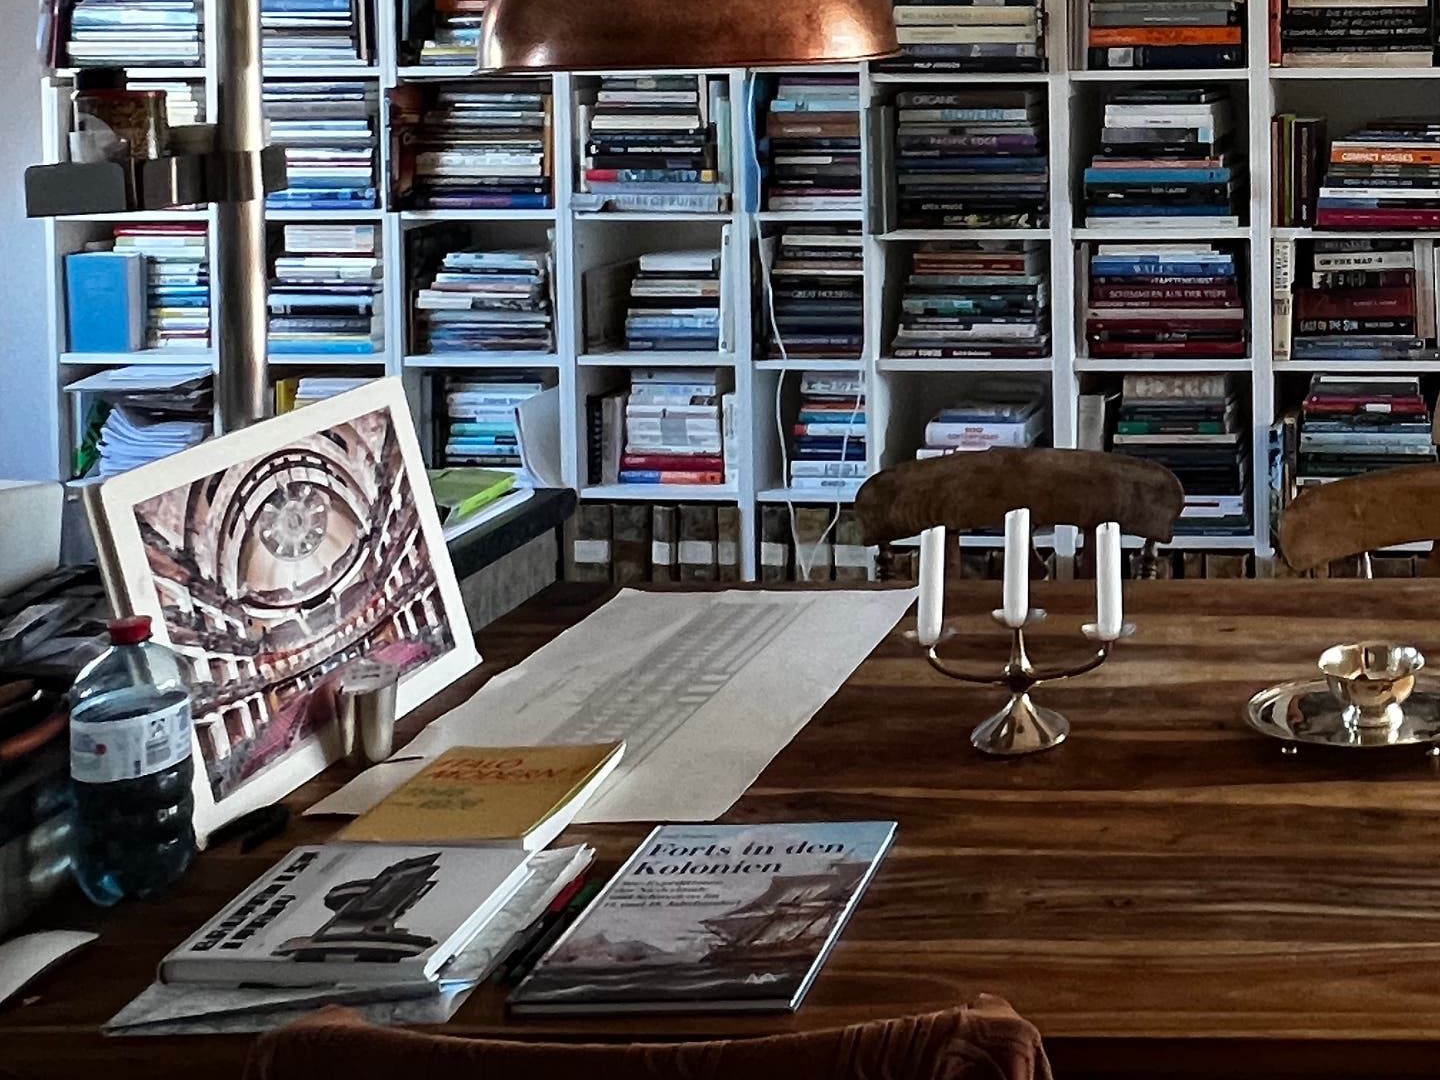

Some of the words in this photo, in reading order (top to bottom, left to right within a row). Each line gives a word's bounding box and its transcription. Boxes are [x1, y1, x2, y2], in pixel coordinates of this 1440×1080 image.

[649, 843, 731, 857] Forts
[742, 841, 775, 856] in
[786, 840, 845, 855] den
[633, 859, 782, 875] Kolonien
